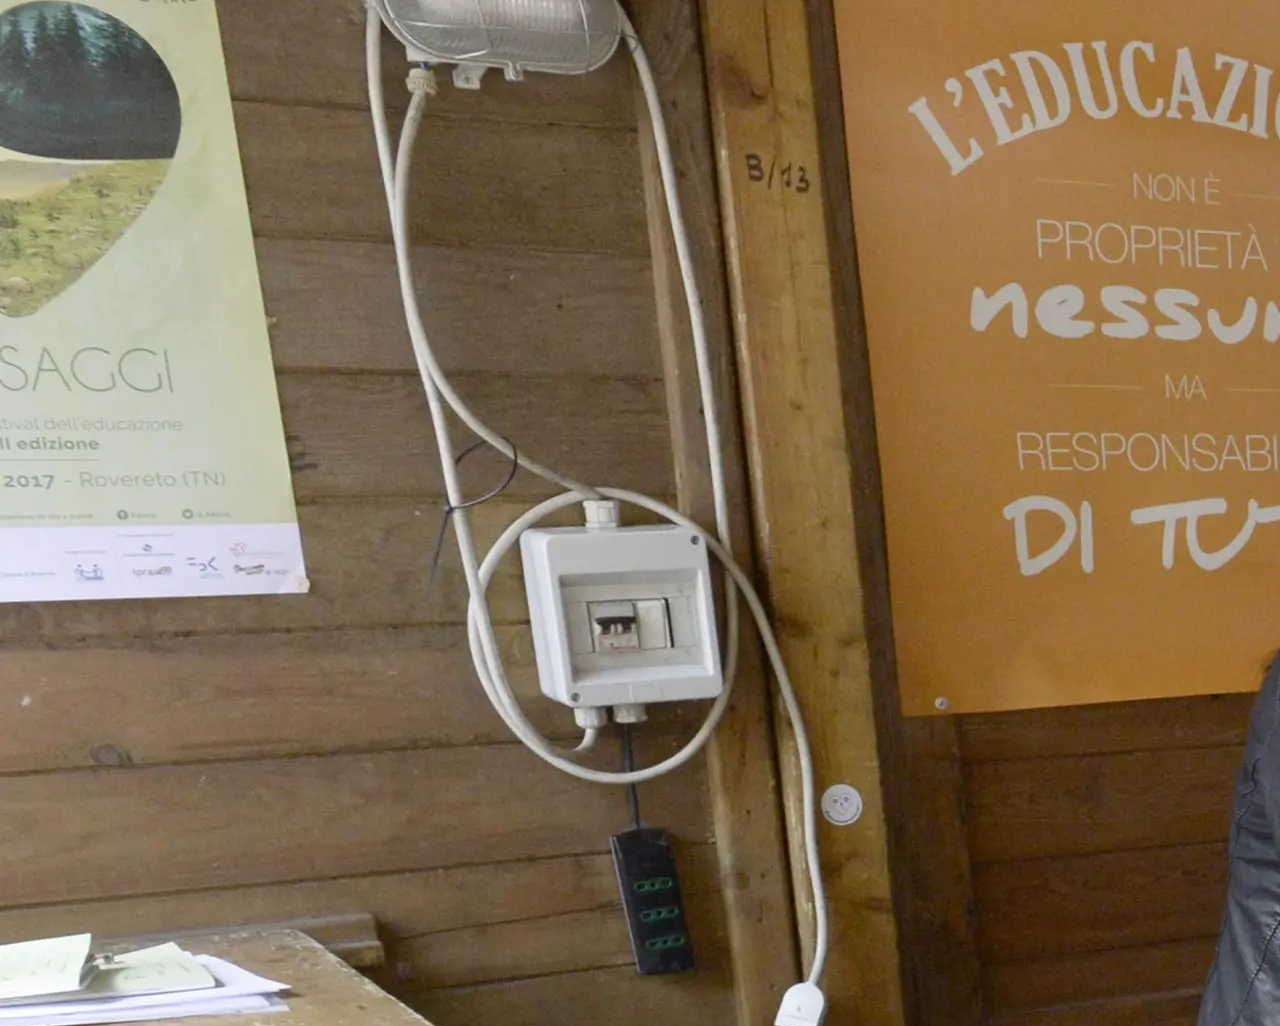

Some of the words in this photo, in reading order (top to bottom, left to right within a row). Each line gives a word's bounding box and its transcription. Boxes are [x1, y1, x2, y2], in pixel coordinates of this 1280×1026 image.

[1132, 172, 1196, 202] NON
[1203, 170, 1222, 206] È
[1035, 217, 1268, 273] PROPRIETÀ
[1164, 375, 1208, 401] MA
[0, 416, 40, 431] tival
[44, 413, 184, 432] dell'educazione
[17, 435, 100, 451] edizione
[4, 474, 54, 489] 2017
[79, 470, 176, 488] Rovereto
[182, 470, 227, 488] (TN)
[1002, 495, 1094, 576] DI
